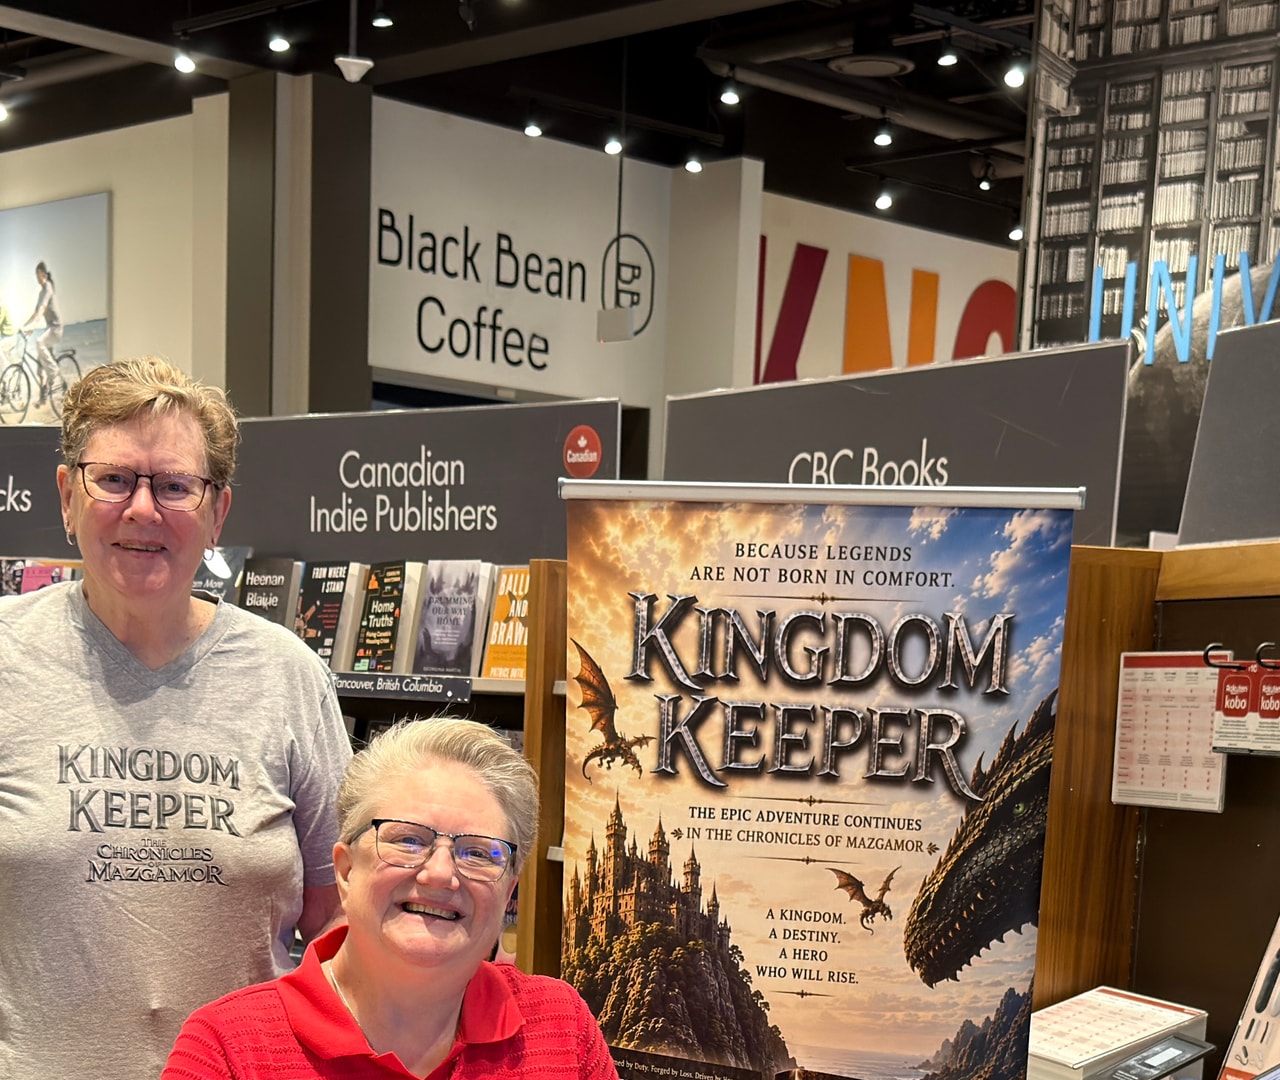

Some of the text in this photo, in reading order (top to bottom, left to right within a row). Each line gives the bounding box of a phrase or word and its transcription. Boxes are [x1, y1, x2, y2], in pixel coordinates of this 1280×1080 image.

[376, 207, 587, 303] Black Bean
[416, 295, 550, 373] Coffee
[339, 444, 465, 488] Canadian
[567, 451, 597, 463] Canadian
[788, 437, 949, 488] CBC Books
[310, 489, 498, 533] Indie Publishers
[735, 542, 912, 562] BECAUSE LEGENDS
[246, 571, 285, 586] Heenan
[690, 566, 955, 588] ARE NOT BORN IN COMFORT.
[371, 601, 395, 613] Home
[369, 613, 394, 628] Truths
[623, 591, 1017, 696] KINGDOM
[650, 693, 985, 803] KEEPER
[57, 743, 240, 791] KINGDOM
[67, 788, 245, 838] KEEPER
[689, 806, 922, 831] THE EPIC ADVENTURE CONTINUES
[141, 838, 167, 847] THE
[686, 827, 924, 853] IN THE CHRONICLES OF MAZGAMOR
[96, 844, 213, 861] CHRONICLES
[85, 859, 230, 887] MAZGAMOR
[766, 908, 847, 925] A KINGDOM.
[768, 928, 841, 944] A DESTINY.
[779, 947, 828, 962] A HERO
[756, 965, 859, 984] WHO WILL RISE.
